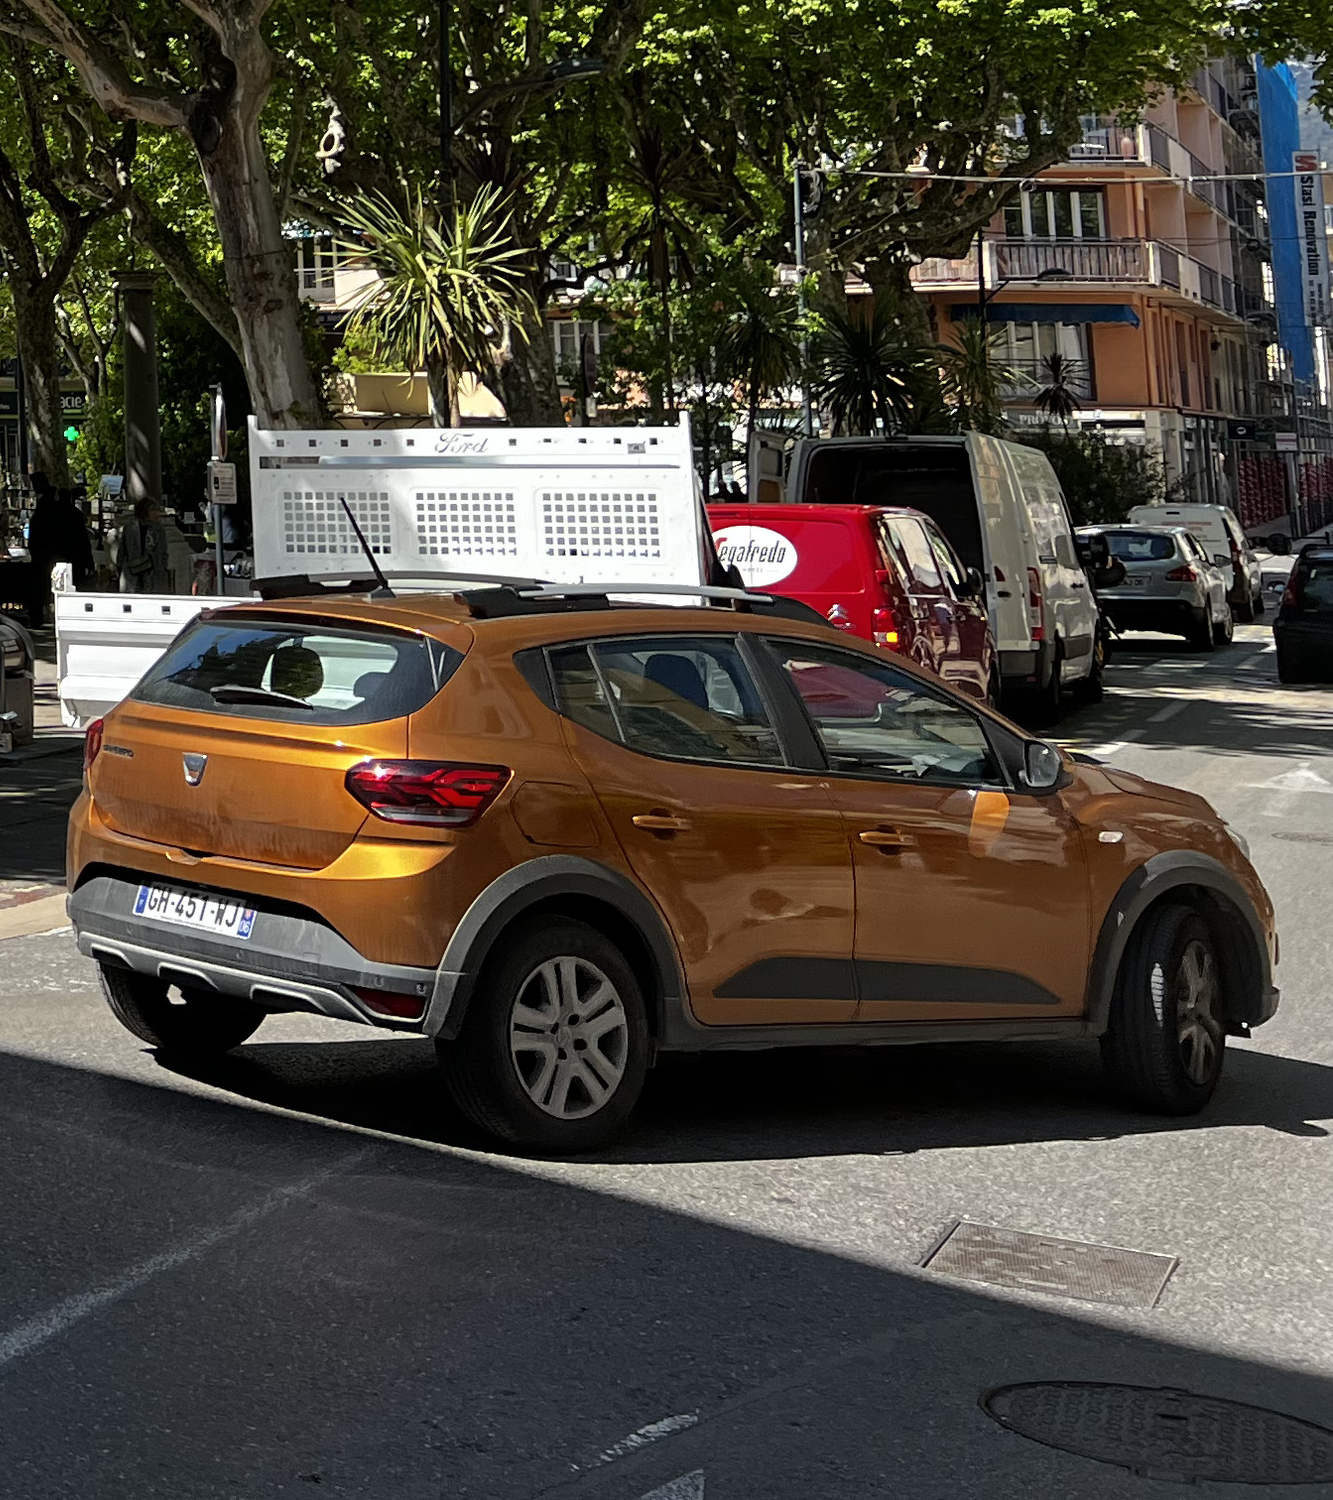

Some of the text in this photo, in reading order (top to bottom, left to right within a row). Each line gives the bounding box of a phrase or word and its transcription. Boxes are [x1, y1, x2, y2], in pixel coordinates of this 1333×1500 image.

[1303, 211, 1321, 275] Renovation
[434, 433, 488, 453] Ford
[147, 885, 239, 928] GH-451-WJ
